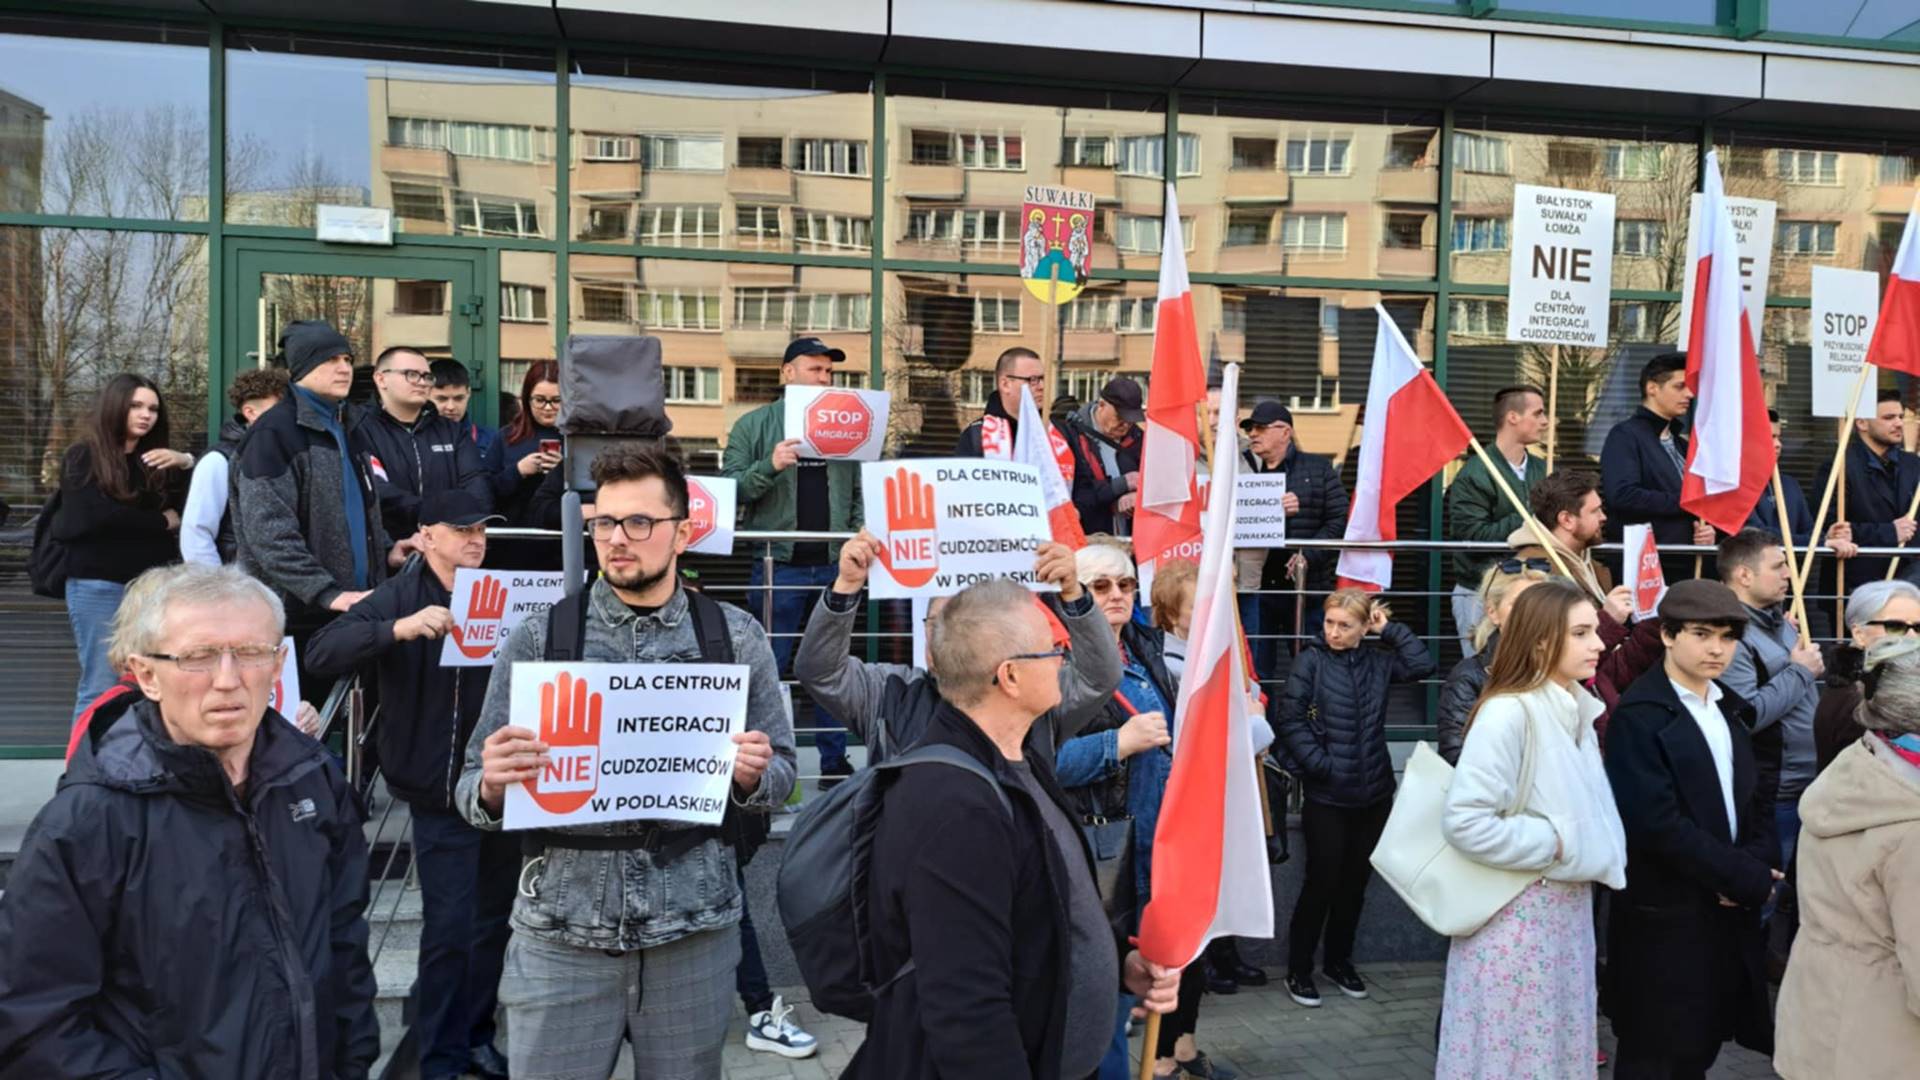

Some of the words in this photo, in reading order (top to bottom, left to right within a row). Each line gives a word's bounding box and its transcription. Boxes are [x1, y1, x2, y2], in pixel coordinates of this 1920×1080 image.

[1026, 186, 1093, 208] SUWAŁKI
[1536, 194, 1593, 209] BIAŁYSTOK
[1541, 208, 1587, 221] SUWAŁKI
[1730, 206, 1758, 217] YSTOK
[1545, 223, 1581, 235] ŁOMŻA
[1532, 244, 1592, 282] NIE
[1551, 290, 1571, 301] DLA
[1534, 302, 1586, 315] CENTRÓW
[1529, 316, 1589, 329] INTEGRACJI
[1824, 312, 1868, 336] STOP
[817, 409, 863, 424] STOP
[937, 469, 968, 482] DLA
[972, 468, 1038, 485] CENTRUM
[1244, 480, 1284, 489] CENTRUM
[947, 503, 1039, 518] INTEGRACJI
[894, 537, 932, 561] NIE
[939, 534, 1038, 555] CUDZOZIEMCÓ
[512, 578, 534, 588] DLA
[536, 578, 564, 588] CENT
[936, 575, 951, 588] W
[512, 602, 552, 613] INTEG
[466, 624, 496, 640] NIE
[609, 676, 646, 690] DLA
[652, 676, 741, 691] CENTRUM
[617, 716, 730, 733] INTEGRACJI
[543, 756, 591, 782] NIE
[601, 755, 730, 775] CUDZOZIEMCÓW
[592, 798, 610, 812] W
[616, 795, 723, 813] PODLASKIEM
